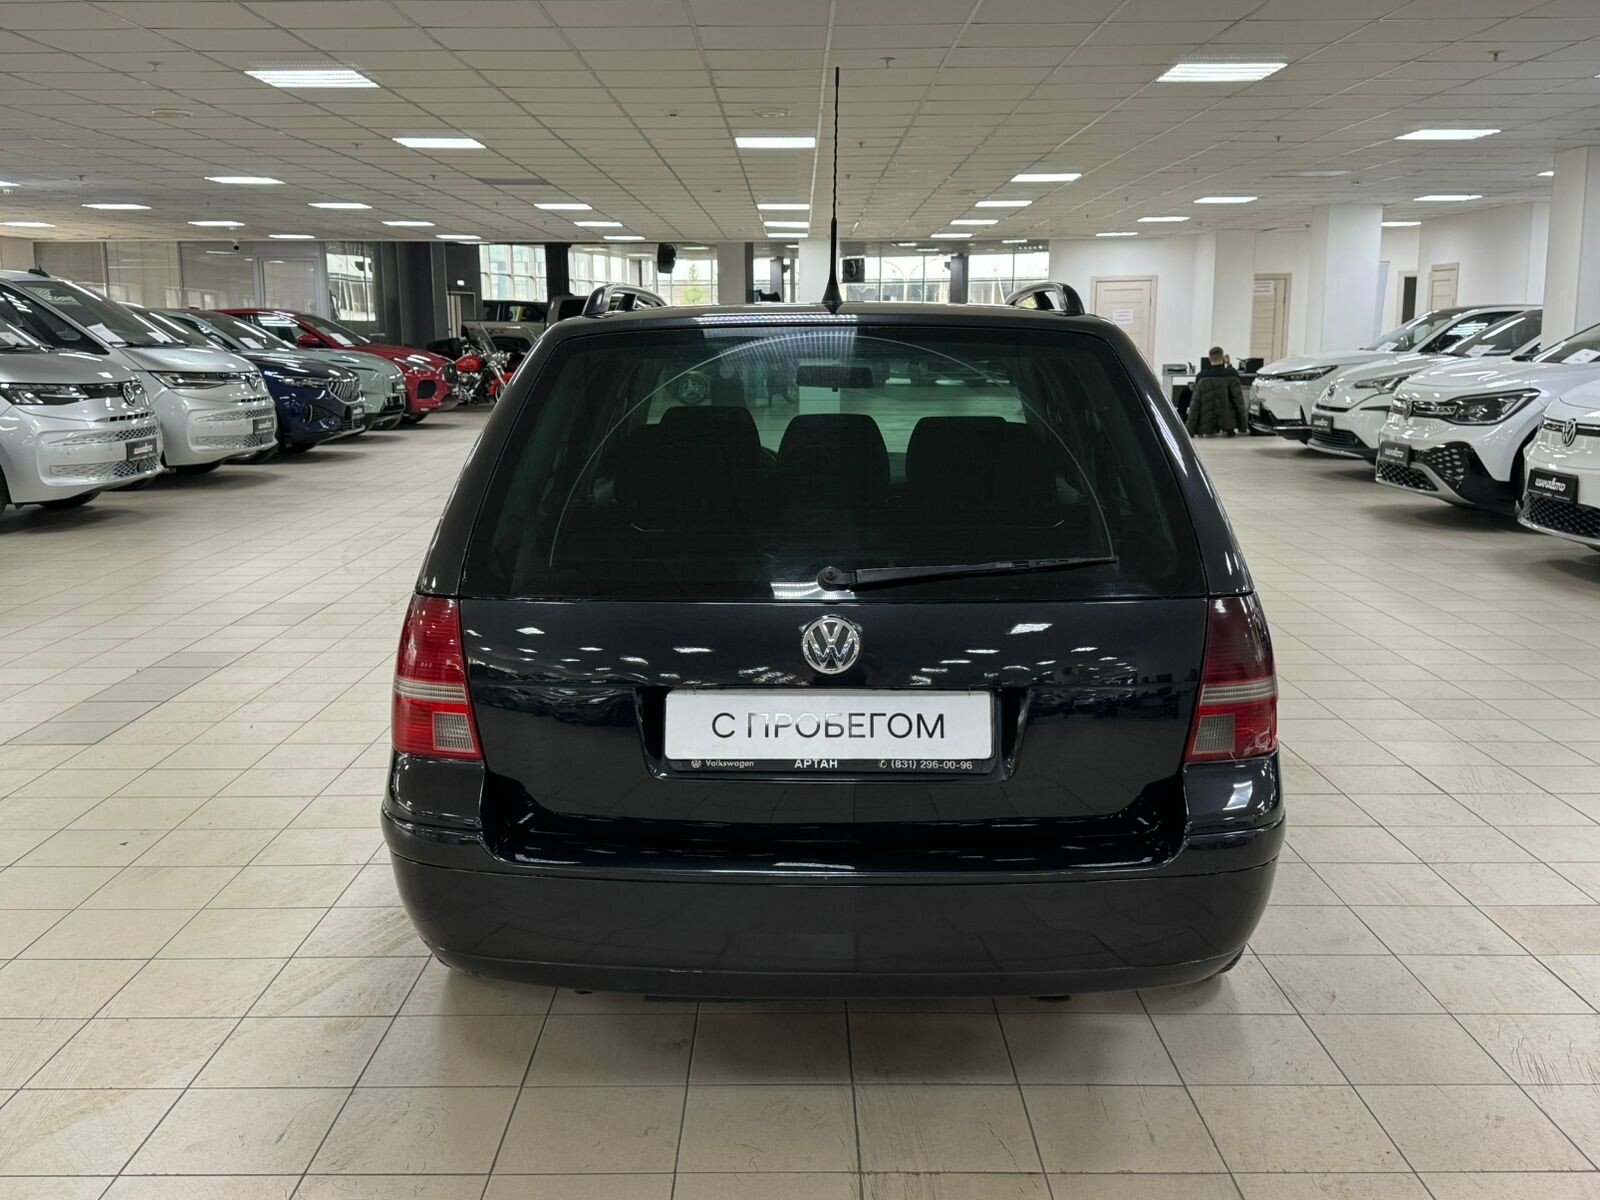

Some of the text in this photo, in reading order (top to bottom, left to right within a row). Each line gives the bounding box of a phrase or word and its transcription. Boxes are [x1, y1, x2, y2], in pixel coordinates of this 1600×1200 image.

[711, 711, 945, 739] С ПРОБЕГОМ
[705, 759, 755, 769] Volkswagen
[794, 759, 838, 769] АРТАН
[890, 760, 973, 770] (831) 296-00-96
